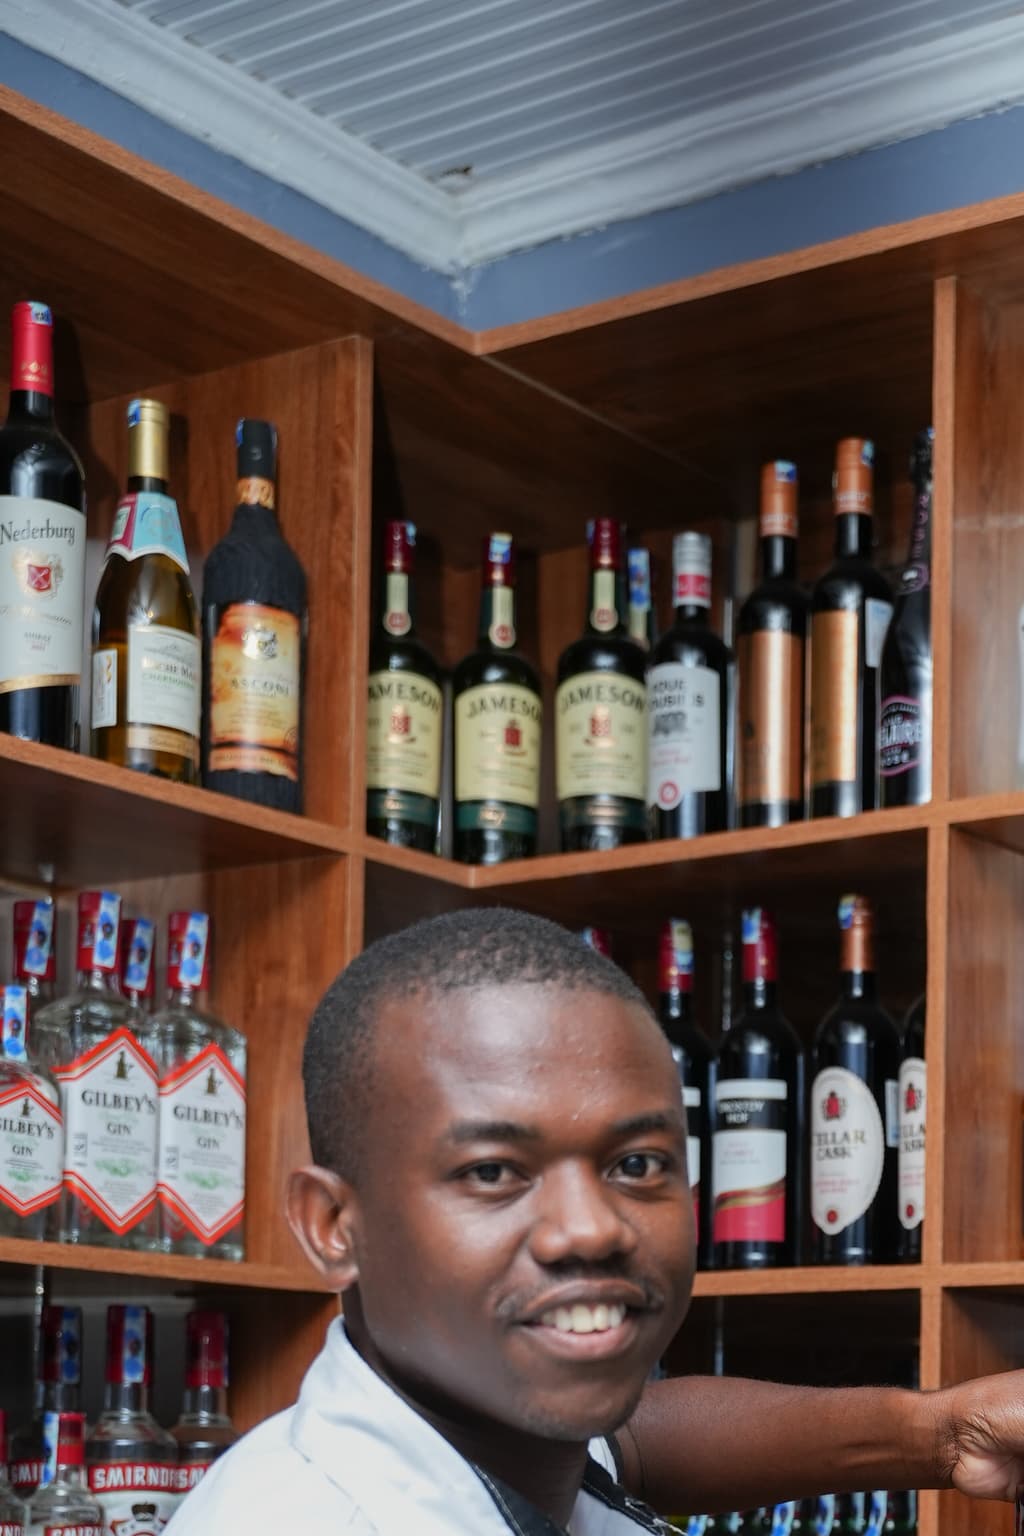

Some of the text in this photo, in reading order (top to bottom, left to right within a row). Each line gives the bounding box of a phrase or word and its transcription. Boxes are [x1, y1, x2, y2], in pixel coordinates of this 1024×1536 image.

[0, 522, 76, 547] Nederburg
[368, 682, 440, 713] AMESON
[466, 696, 542, 722] JAMESO
[82, 1089, 156, 1114] GILBEY'S
[173, 1104, 243, 1128] GILBEY'S
[106, 1122, 132, 1136] GIN
[814, 1130, 865, 1147] ELLAR
[11, 1143, 33, 1157] GIN
[196, 1136, 221, 1149] GIN
[93, 1466, 176, 1489] SMIRNO
